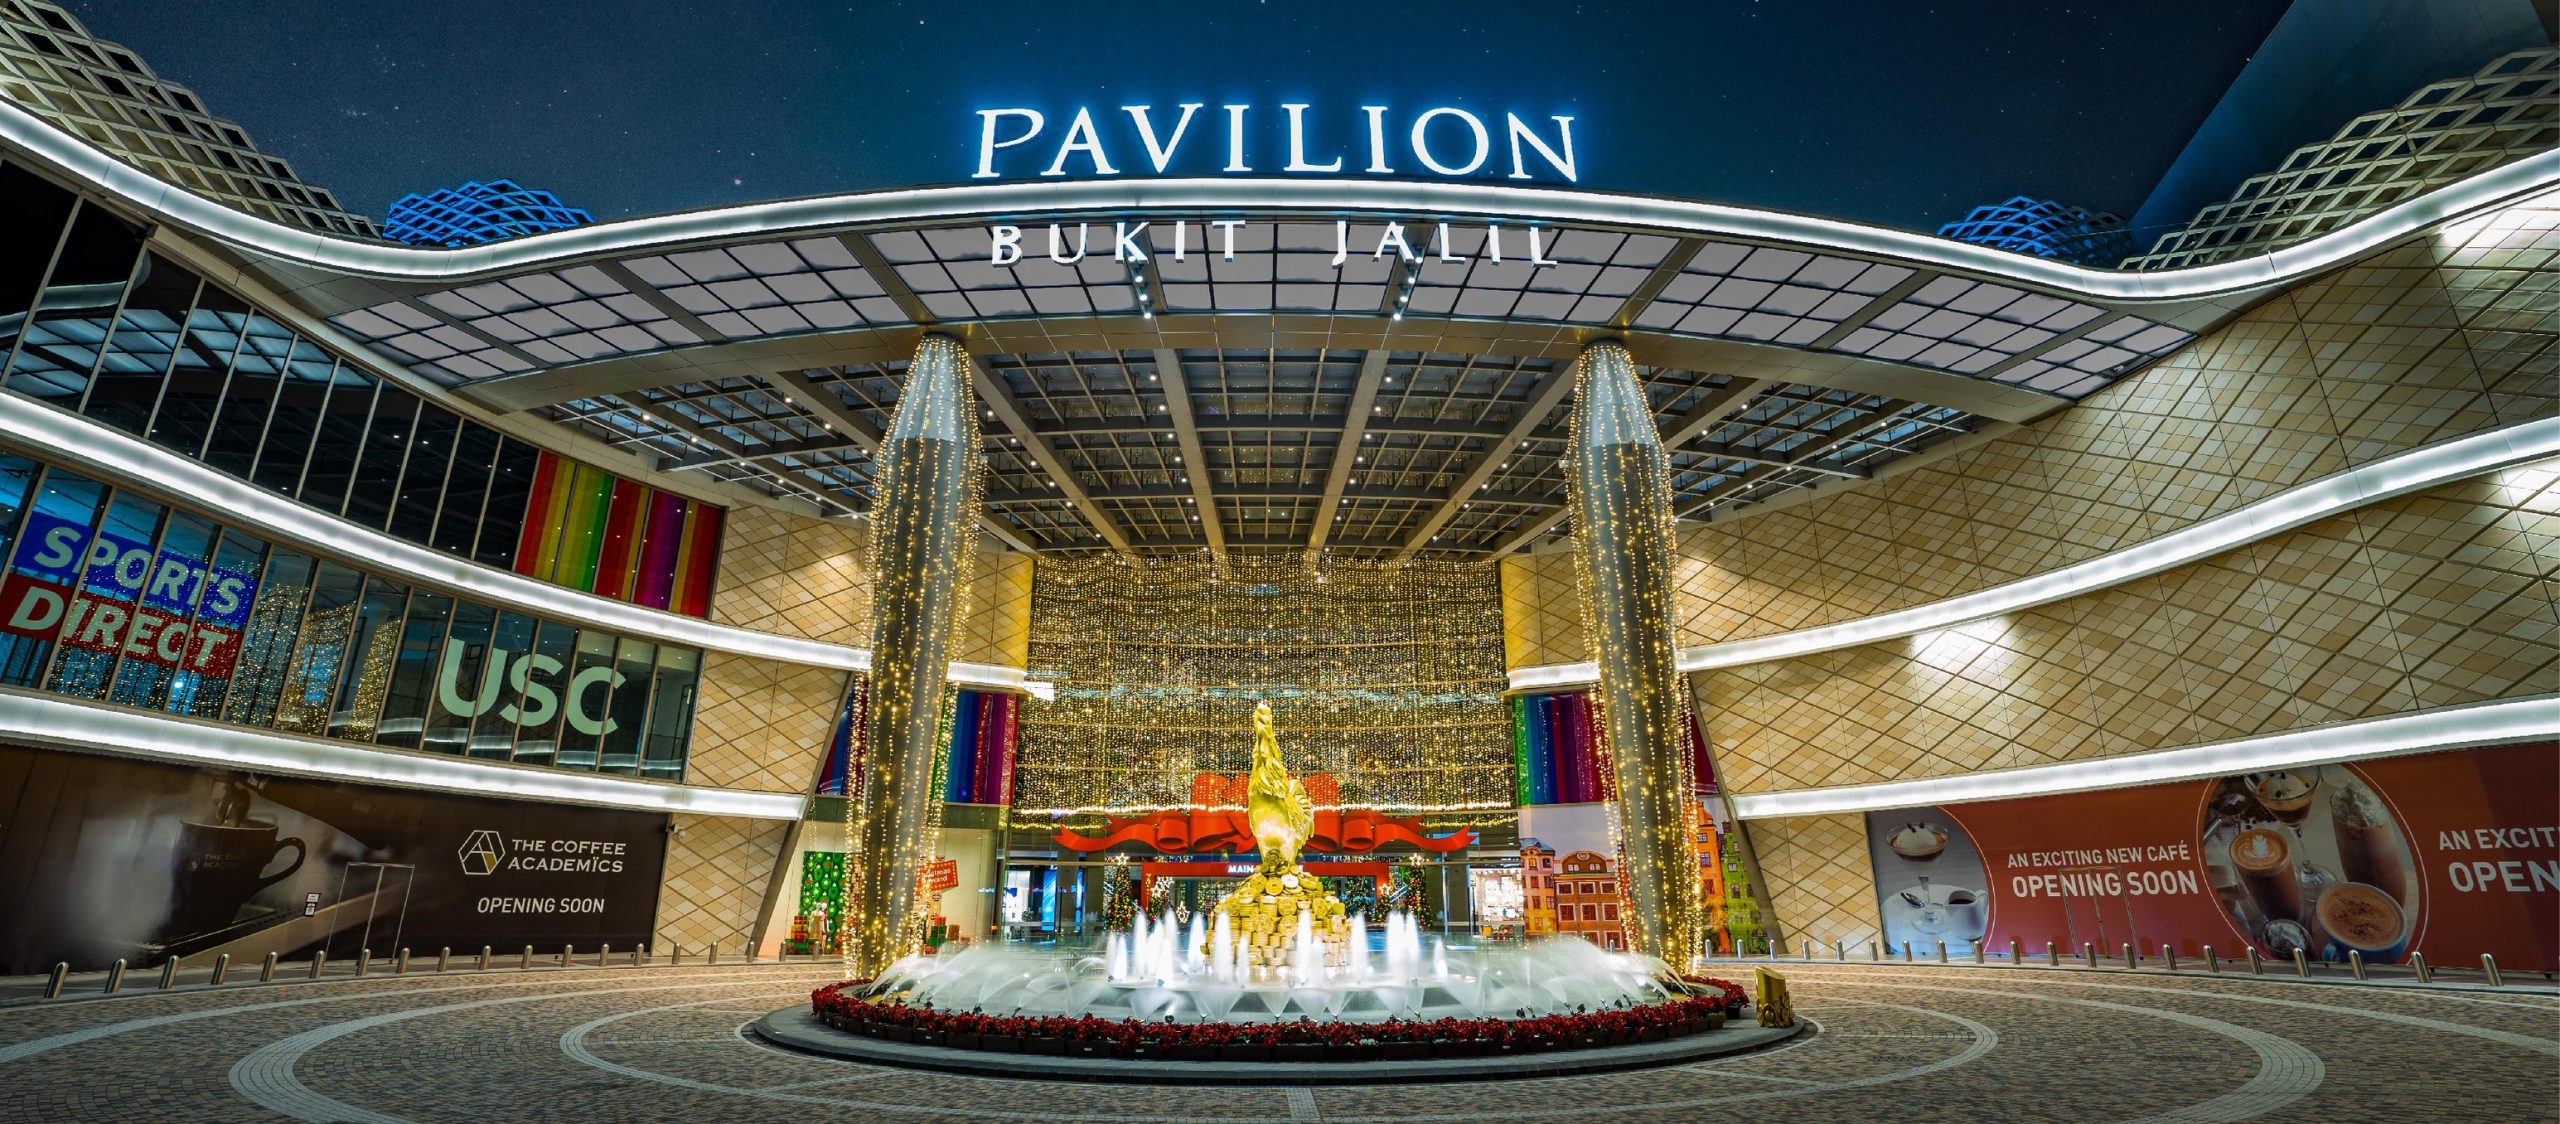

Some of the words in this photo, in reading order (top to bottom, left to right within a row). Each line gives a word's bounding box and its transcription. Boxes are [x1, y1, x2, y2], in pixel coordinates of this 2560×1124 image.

[972, 103, 1577, 182] PAVILION
[991, 220, 1246, 267] BUKIT
[1332, 220, 1557, 269] JALIL
[34, 526, 246, 615] SPORTS
[8, 585, 229, 668] DIRECT
[439, 638, 627, 736] USC
[512, 839, 546, 852] THE
[551, 840, 626, 855] COFFEE
[2439, 830, 2472, 850] AN
[2474, 826, 2559, 849] EXCIT
[2008, 853, 2029, 868] AN
[2032, 849, 2103, 867] EXCITING
[2106, 847, 2143, 864] NEW
[2147, 839, 2191, 862] CAFÉ
[1228, 865, 1254, 873] MAIN
[2012, 872, 2123, 898] OPENING
[2126, 869, 2199, 896] SOON
[2448, 860, 2559, 892] OPEN
[477, 897, 555, 913] OPENING
[559, 898, 605, 913] SOON
